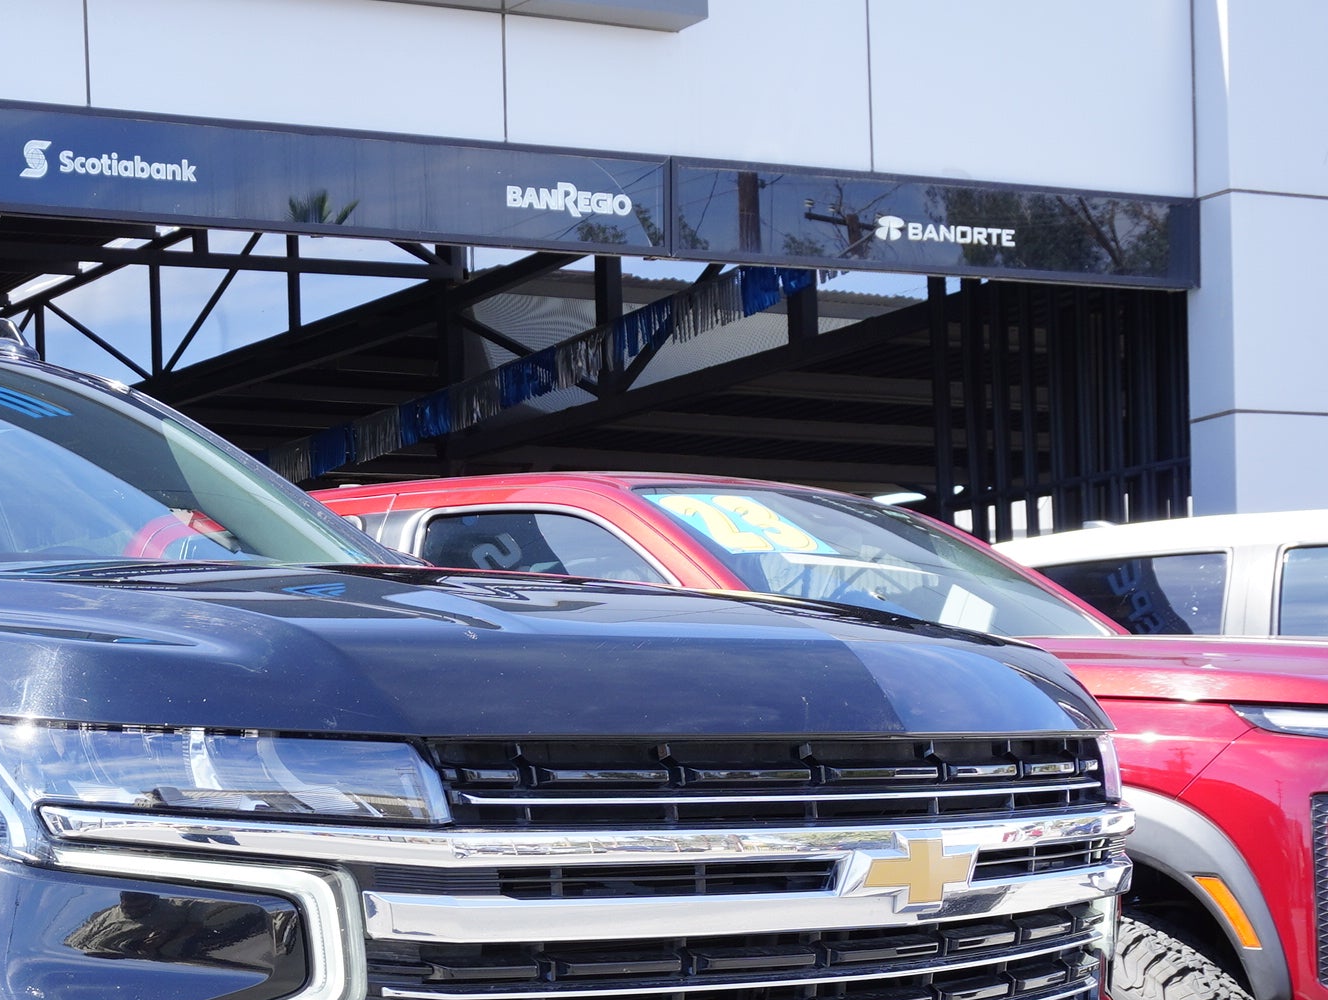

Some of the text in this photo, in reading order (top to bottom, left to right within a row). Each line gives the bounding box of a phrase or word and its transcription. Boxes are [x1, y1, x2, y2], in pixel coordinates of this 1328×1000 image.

[58, 148, 198, 183] Scotiabank
[506, 181, 633, 218] BANREGIO
[907, 221, 1016, 248] BANORTE
[659, 494, 819, 552] 23
